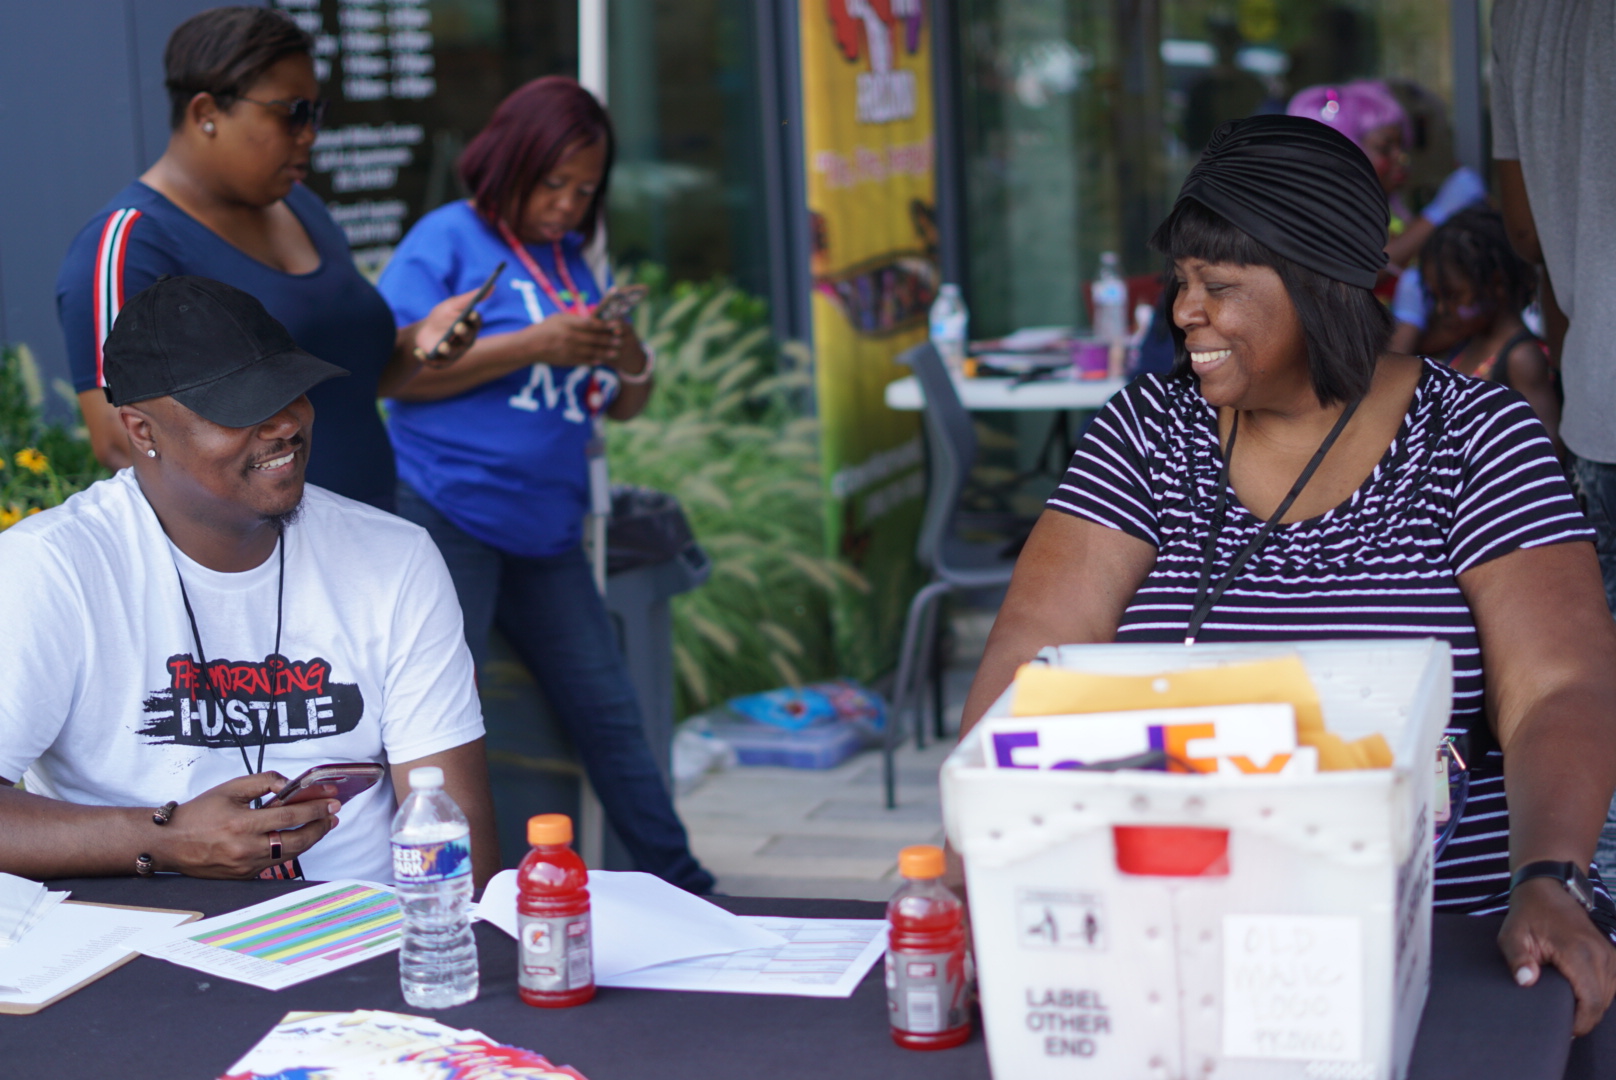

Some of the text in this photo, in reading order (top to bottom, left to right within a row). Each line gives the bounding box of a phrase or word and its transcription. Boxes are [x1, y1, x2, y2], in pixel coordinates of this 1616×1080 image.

[170, 660, 325, 702] THE MORNING
[180, 696, 337, 737] HUSTLE
[522, 922, 551, 954] G
[1245, 926, 1317, 955] OLD
[1025, 987, 1108, 1011] LABEL
[1025, 1011, 1111, 1035] OTHER
[1044, 1035, 1096, 1058] END
